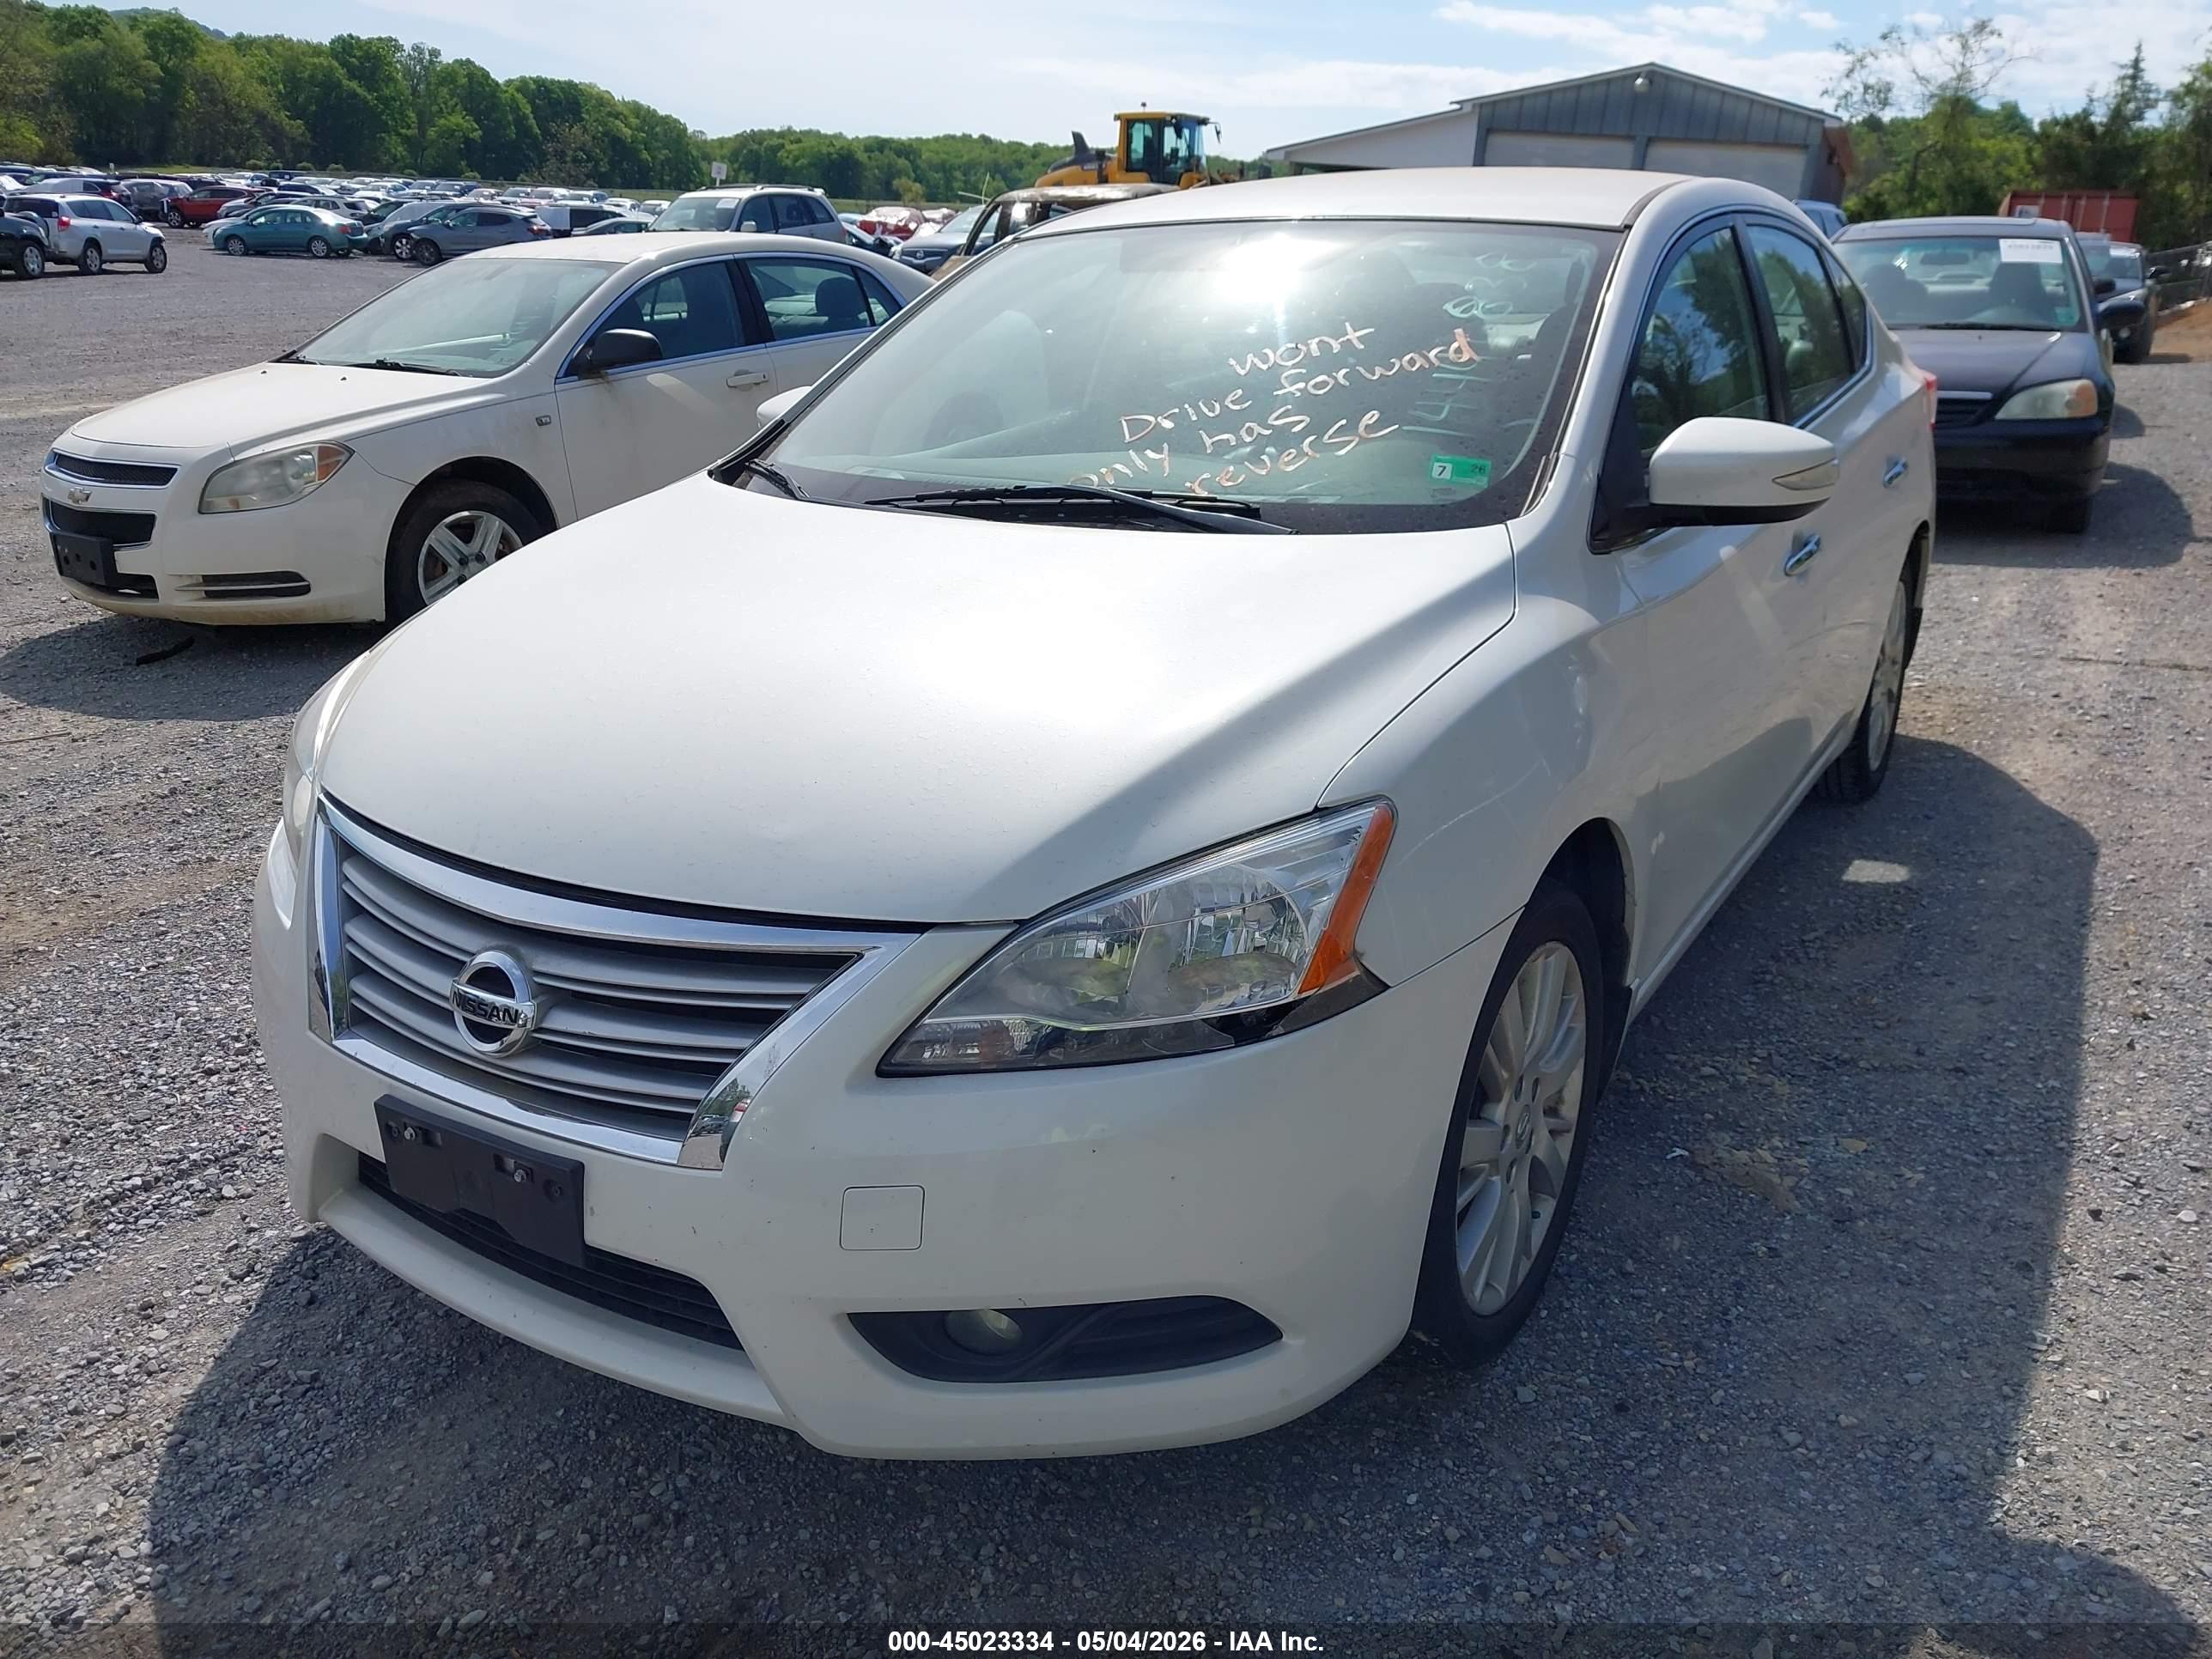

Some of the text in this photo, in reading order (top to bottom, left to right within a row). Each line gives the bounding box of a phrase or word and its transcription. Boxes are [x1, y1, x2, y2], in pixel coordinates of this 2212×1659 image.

[1118, 327, 1480, 443] Drive forward
[1184, 409, 1399, 495] reverse
[1200, 404, 1311, 453] has
[1437, 464, 1486, 477] 7 26
[452, 989, 520, 1024] NISSAN
